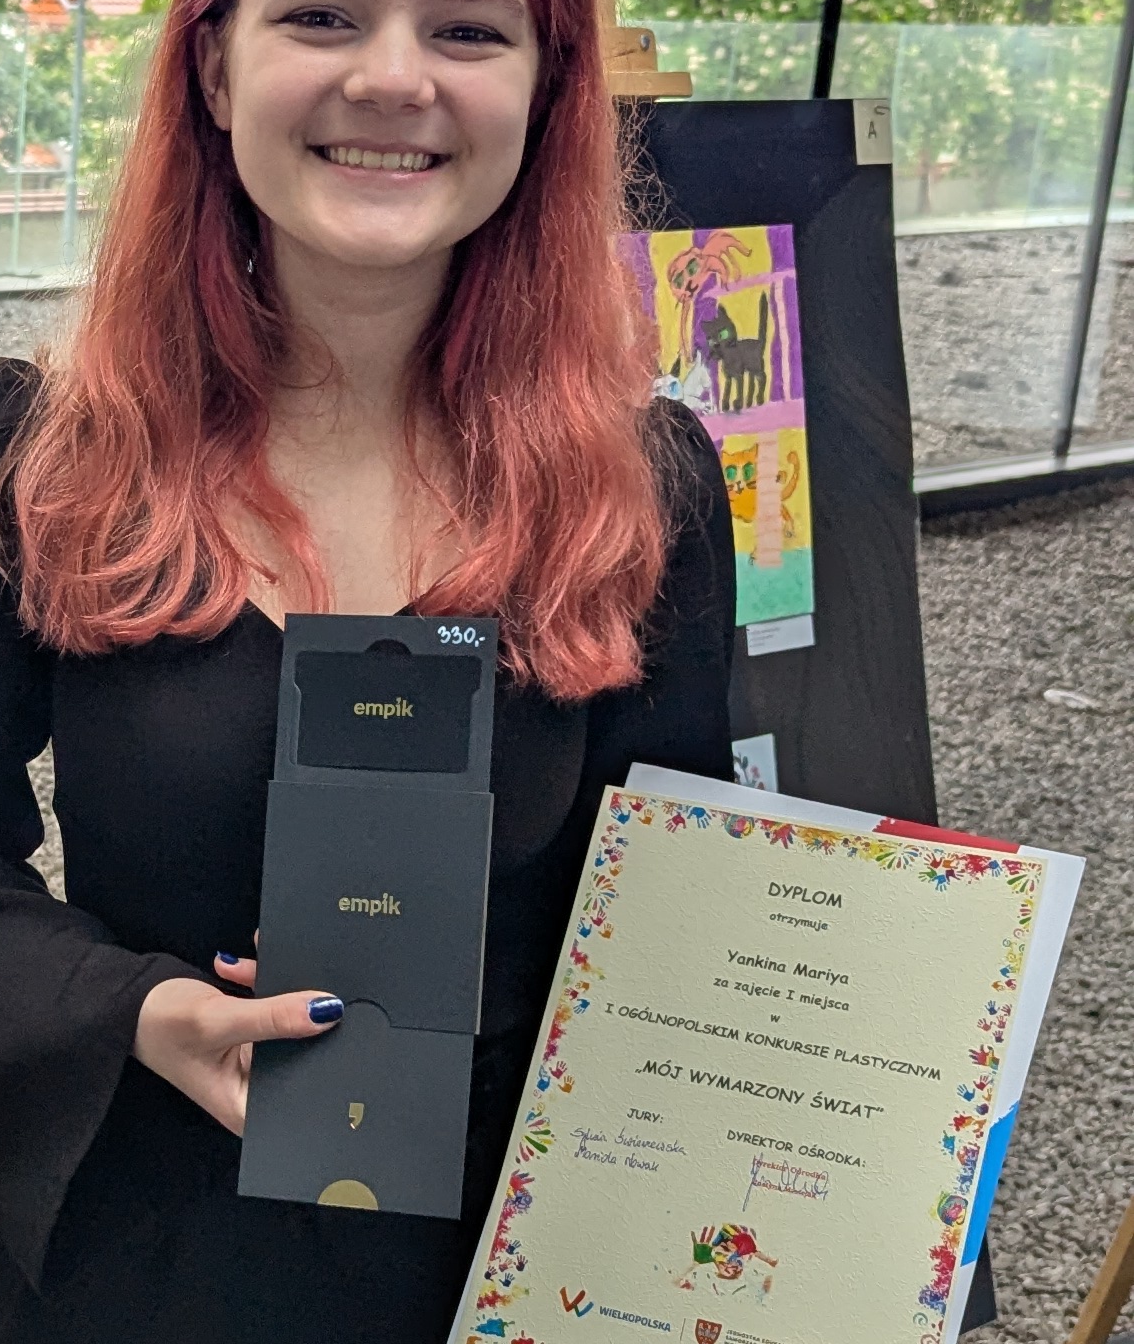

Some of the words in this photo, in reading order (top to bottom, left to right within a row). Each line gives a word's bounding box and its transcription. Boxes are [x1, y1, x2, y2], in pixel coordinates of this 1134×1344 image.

[867, 120, 877, 139] A
[353, 697, 414, 719] empik
[338, 892, 402, 917] empik
[767, 881, 843, 909] DYPLOM
[768, 912, 829, 932] otrzymuje
[726, 949, 787, 974] Yankina
[792, 962, 850, 986] Mariya
[712, 976, 729, 989] za
[733, 980, 781, 999] zajęcie
[785, 989, 796, 1001] I
[799, 991, 850, 1012] miejsca
[769, 1013, 781, 1024] w
[604, 1002, 615, 1014] I
[617, 1004, 740, 1041] OGÓLNOPOLSKIM
[744, 1031, 831, 1059] KONKURSIE
[834, 1048, 942, 1081] PLASTYCZNYM
[689, 1068, 805, 1105] WYMARZONY
[626, 1107, 664, 1124] JURY:
[726, 1129, 794, 1153] DYREKTOR
[798, 1143, 867, 1168] OŚRODKA:
[599, 1306, 671, 1333] WIELKOPOLSKA
